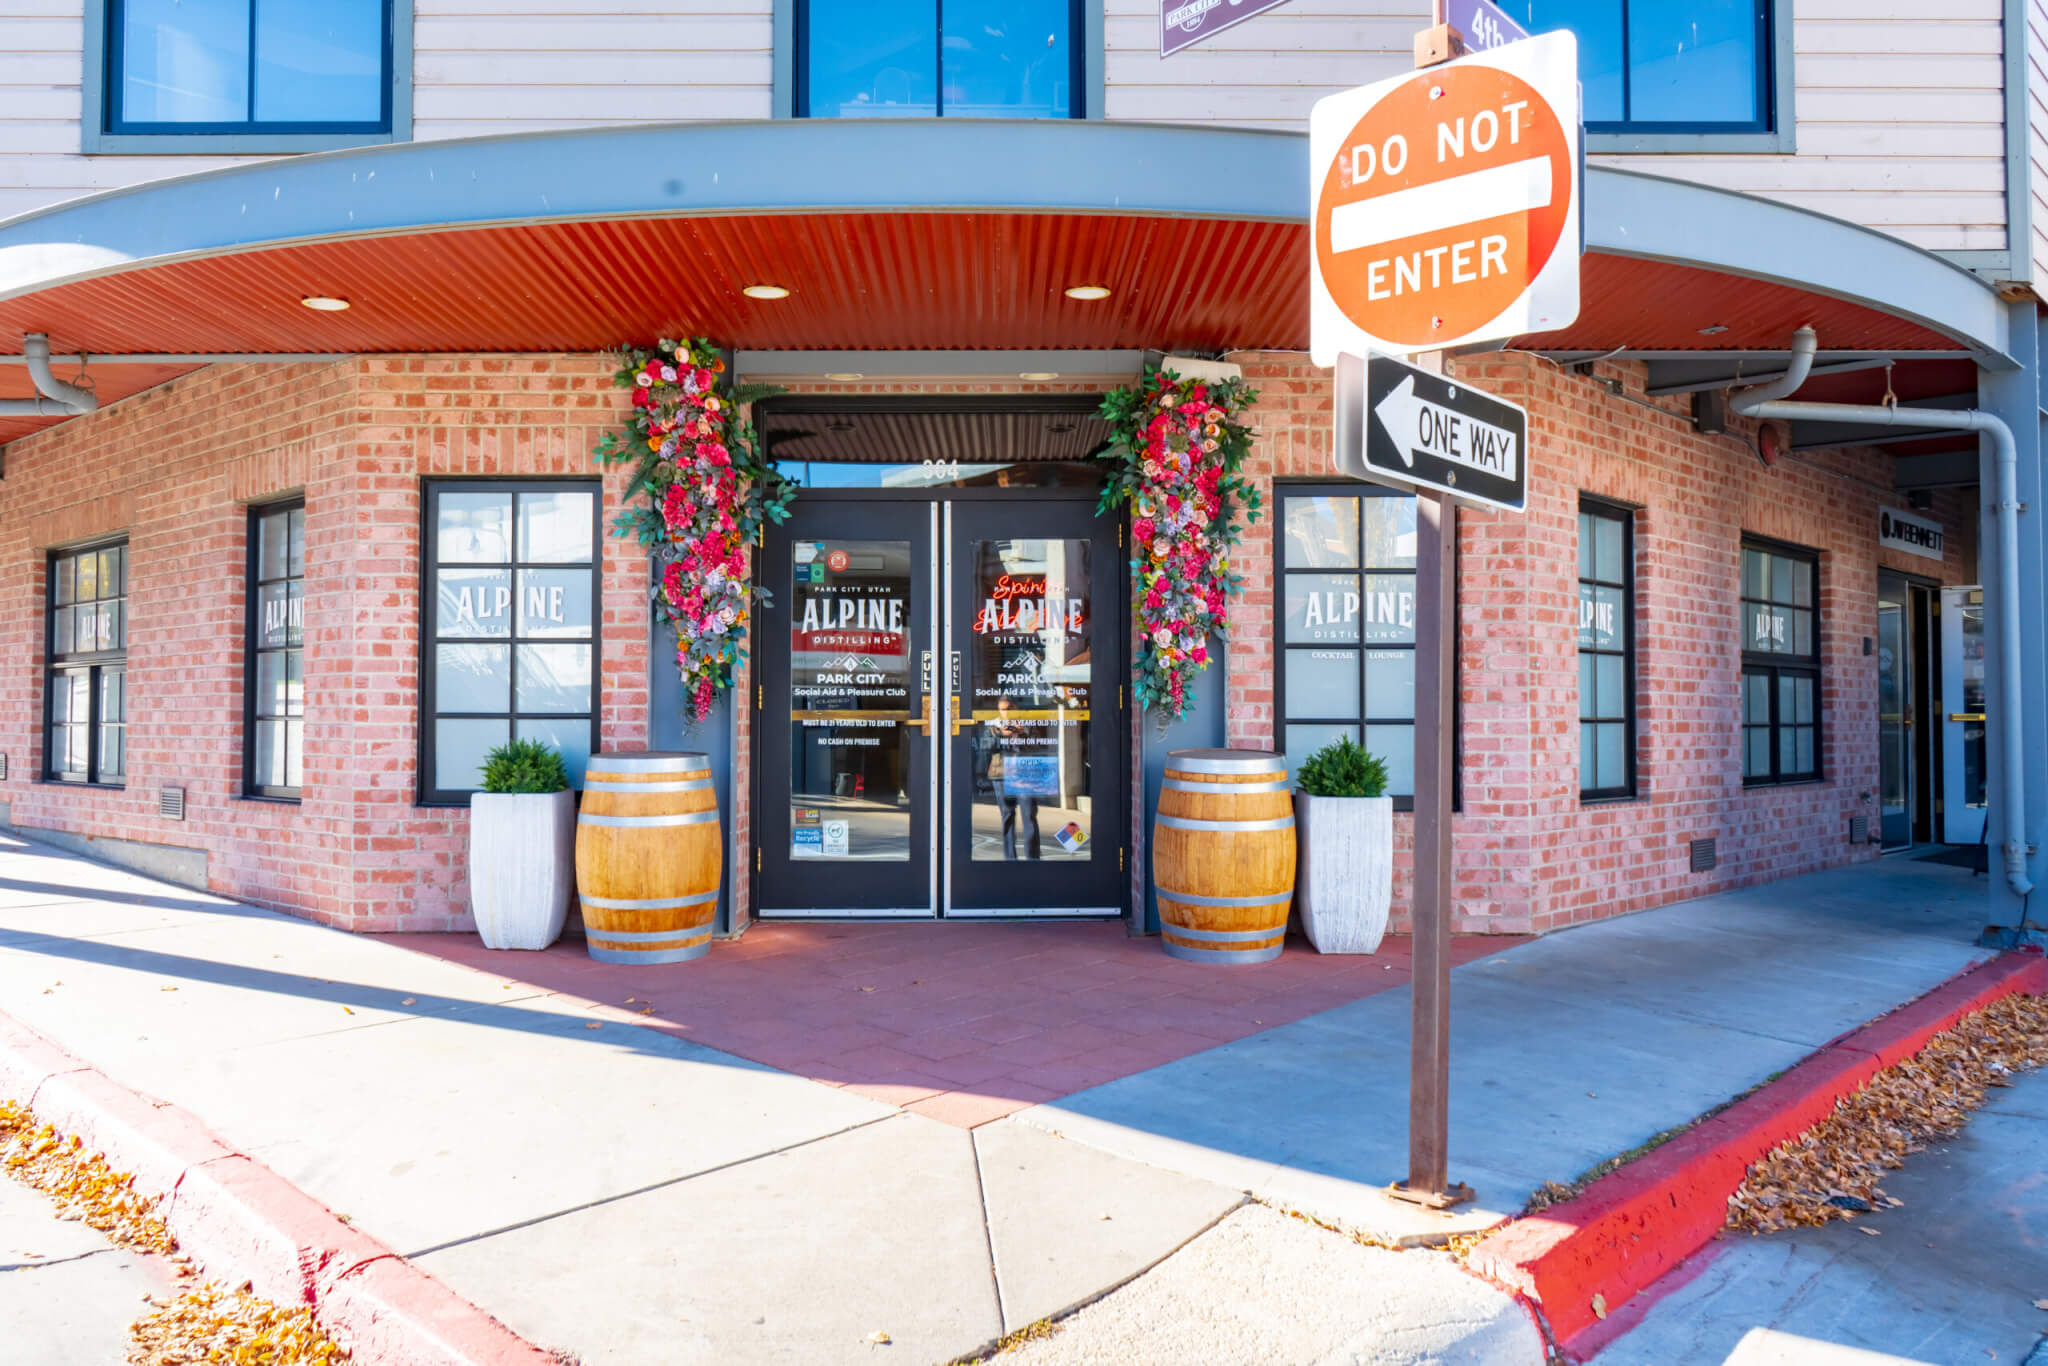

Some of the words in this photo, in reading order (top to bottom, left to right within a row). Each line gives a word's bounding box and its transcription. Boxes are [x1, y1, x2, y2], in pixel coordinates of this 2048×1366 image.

[1471, 8, 1504, 48] 4th
[1351, 134, 1408, 185] DO
[1437, 100, 1528, 163] NOT
[1367, 234, 1508, 301] ENTER
[1419, 405, 1461, 458] ONE
[1470, 423, 1510, 472] WAY
[456, 585, 565, 624] ALPINE
[801, 598, 904, 635] ALPINE
[982, 598, 1082, 635] ALPINE
[1304, 591, 1413, 629] ALPINE
[1577, 599, 1614, 636] LPINE
[816, 673, 853, 684] PARK
[856, 673, 886, 684] CITY
[923, 652, 931, 690] PULL
[997, 673, 1033, 684] PARK
[794, 687, 819, 696] Social
[822, 687, 837, 696] Aid
[839, 688, 845, 696] &
[848, 687, 884, 696] Pleasure
[885, 687, 906, 696] Club
[975, 687, 1001, 696] Social
[1003, 687, 1017, 696] Aid
[1020, 688, 1026, 696] &
[1066, 687, 1087, 696] Club
[836, 719, 854, 727] YEARS
[869, 719, 876, 727] TO
[877, 719, 896, 727] ENTER
[818, 738, 827, 746] NO
[828, 738, 844, 746] CASH
[845, 738, 853, 746] ON
[854, 738, 880, 746] PREMISE
